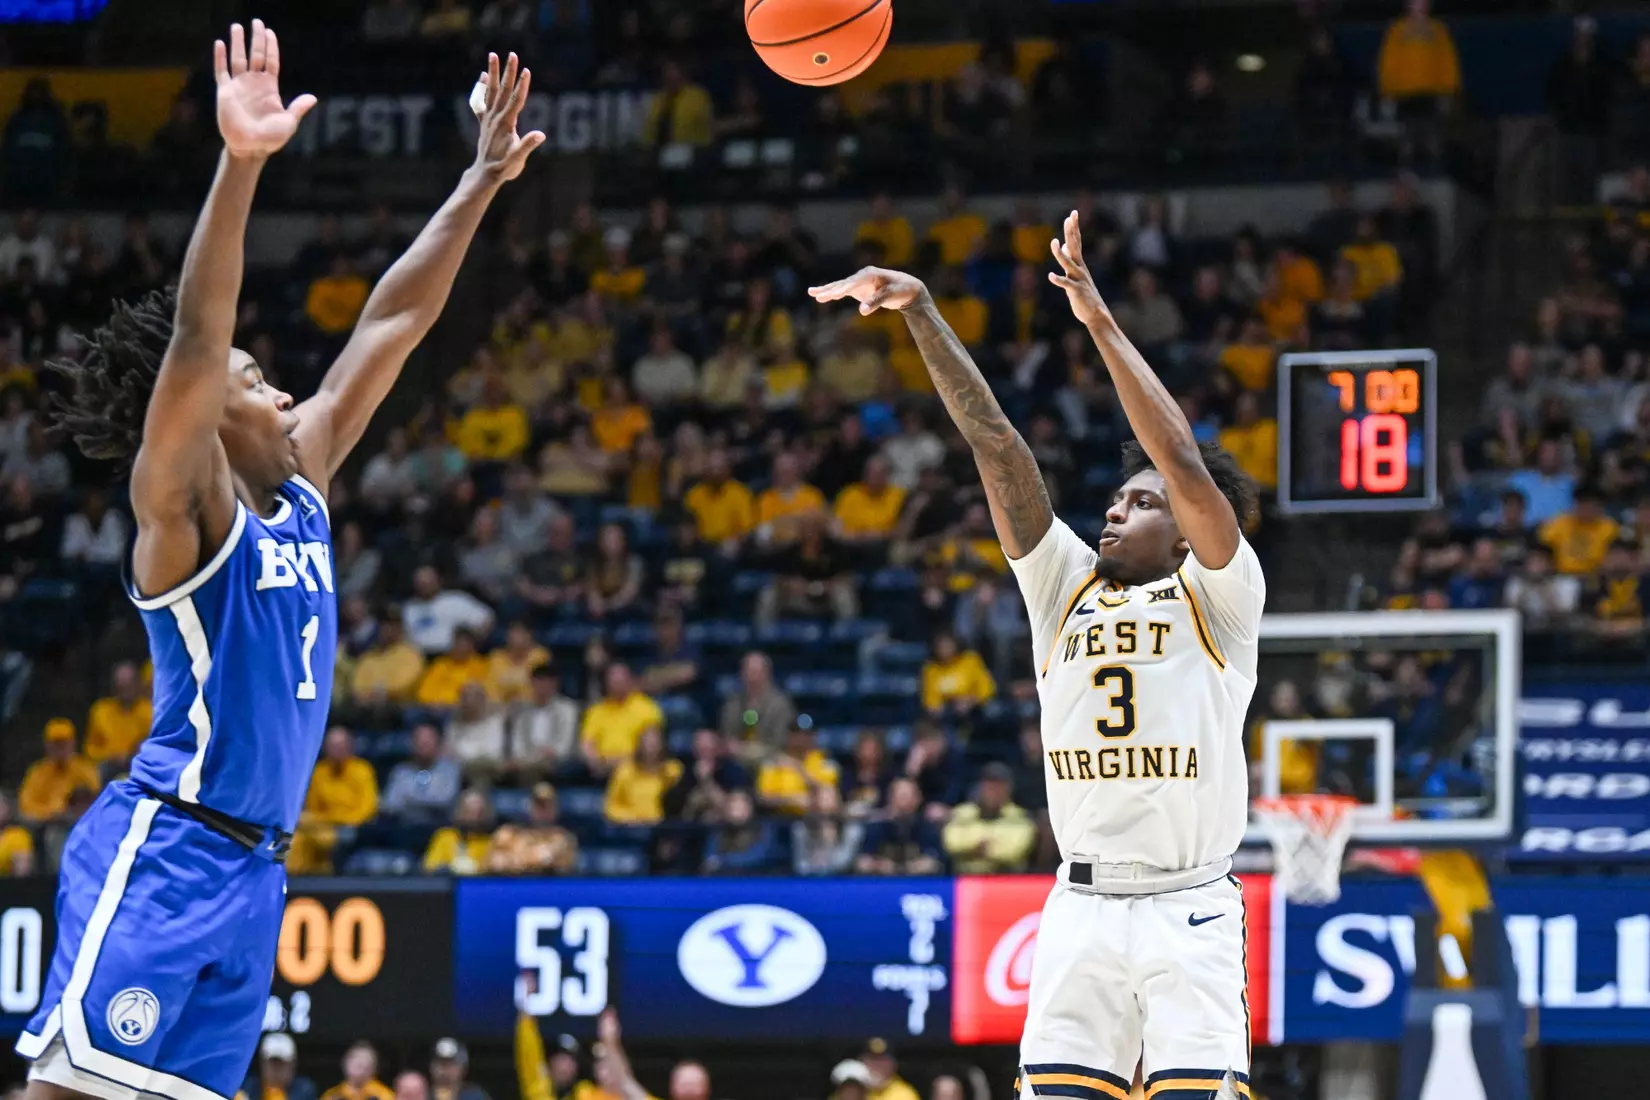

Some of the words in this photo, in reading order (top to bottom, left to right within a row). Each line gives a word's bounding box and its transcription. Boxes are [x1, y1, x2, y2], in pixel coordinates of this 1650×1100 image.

[1340, 413, 1408, 493] 18
[296, 615, 319, 700] 1
[1063, 620, 1171, 663] WEST
[1092, 663, 1138, 740] 3
[1047, 746, 1199, 781] VIRGINIA
[514, 906, 610, 1016] 53
